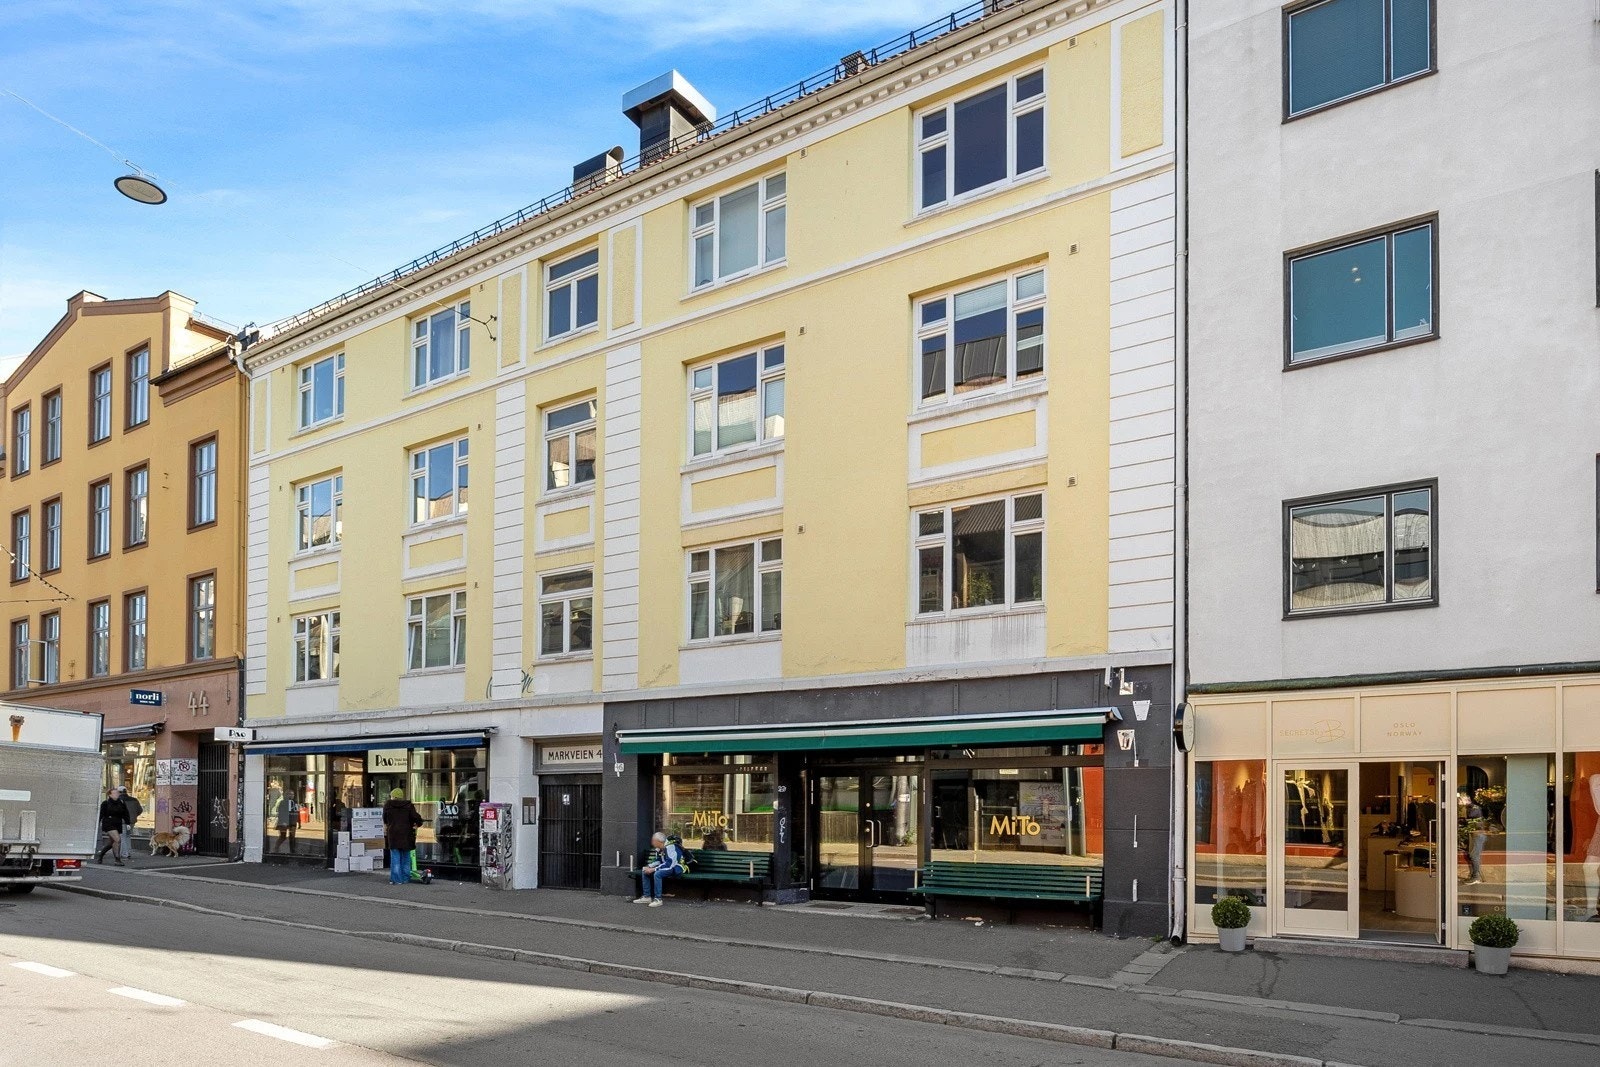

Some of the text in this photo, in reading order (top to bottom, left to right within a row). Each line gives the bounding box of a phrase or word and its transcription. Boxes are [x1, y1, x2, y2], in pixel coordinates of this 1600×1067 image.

[135, 692, 160, 701] norli
[188, 690, 210, 717] 44
[229, 729, 247, 738] Pao
[375, 754, 394, 767] Pao
[548, 749, 594, 761] MARKVEIEN
[437, 800, 459, 815] Pao
